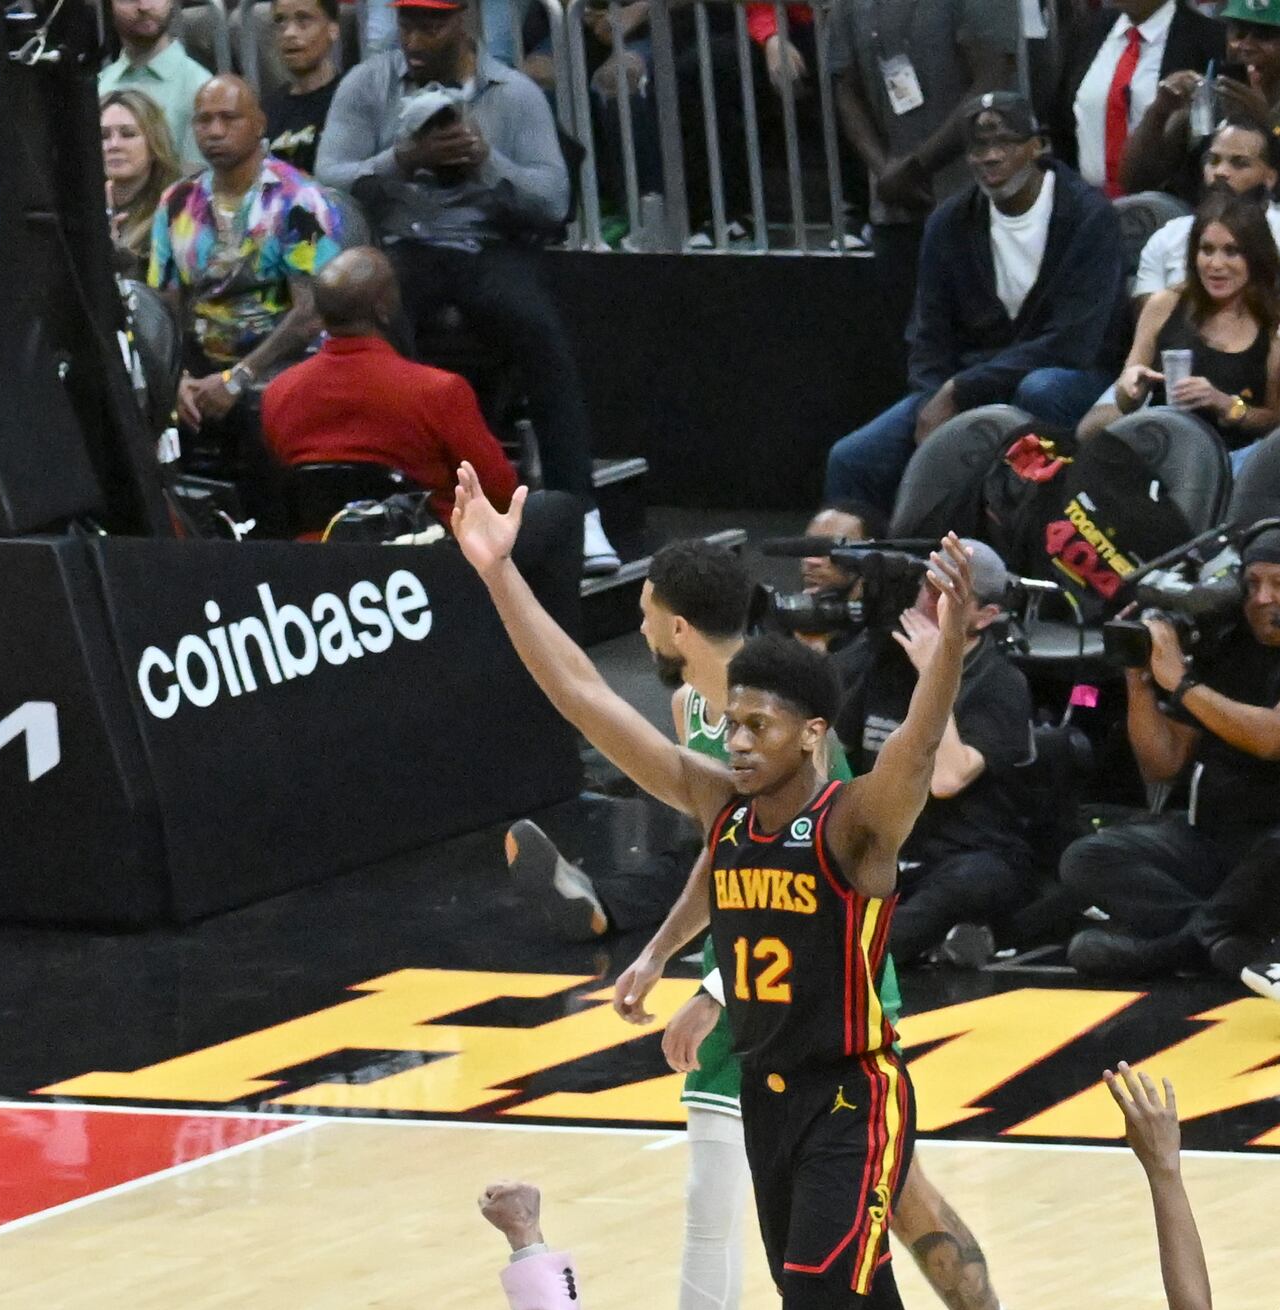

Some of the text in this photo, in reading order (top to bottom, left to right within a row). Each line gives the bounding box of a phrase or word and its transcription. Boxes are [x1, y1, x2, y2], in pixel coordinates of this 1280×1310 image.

[1045, 519, 1125, 599] 404
[137, 569, 433, 719] coinbase
[713, 868, 818, 915] HAWKS
[732, 936, 794, 1005] 12
